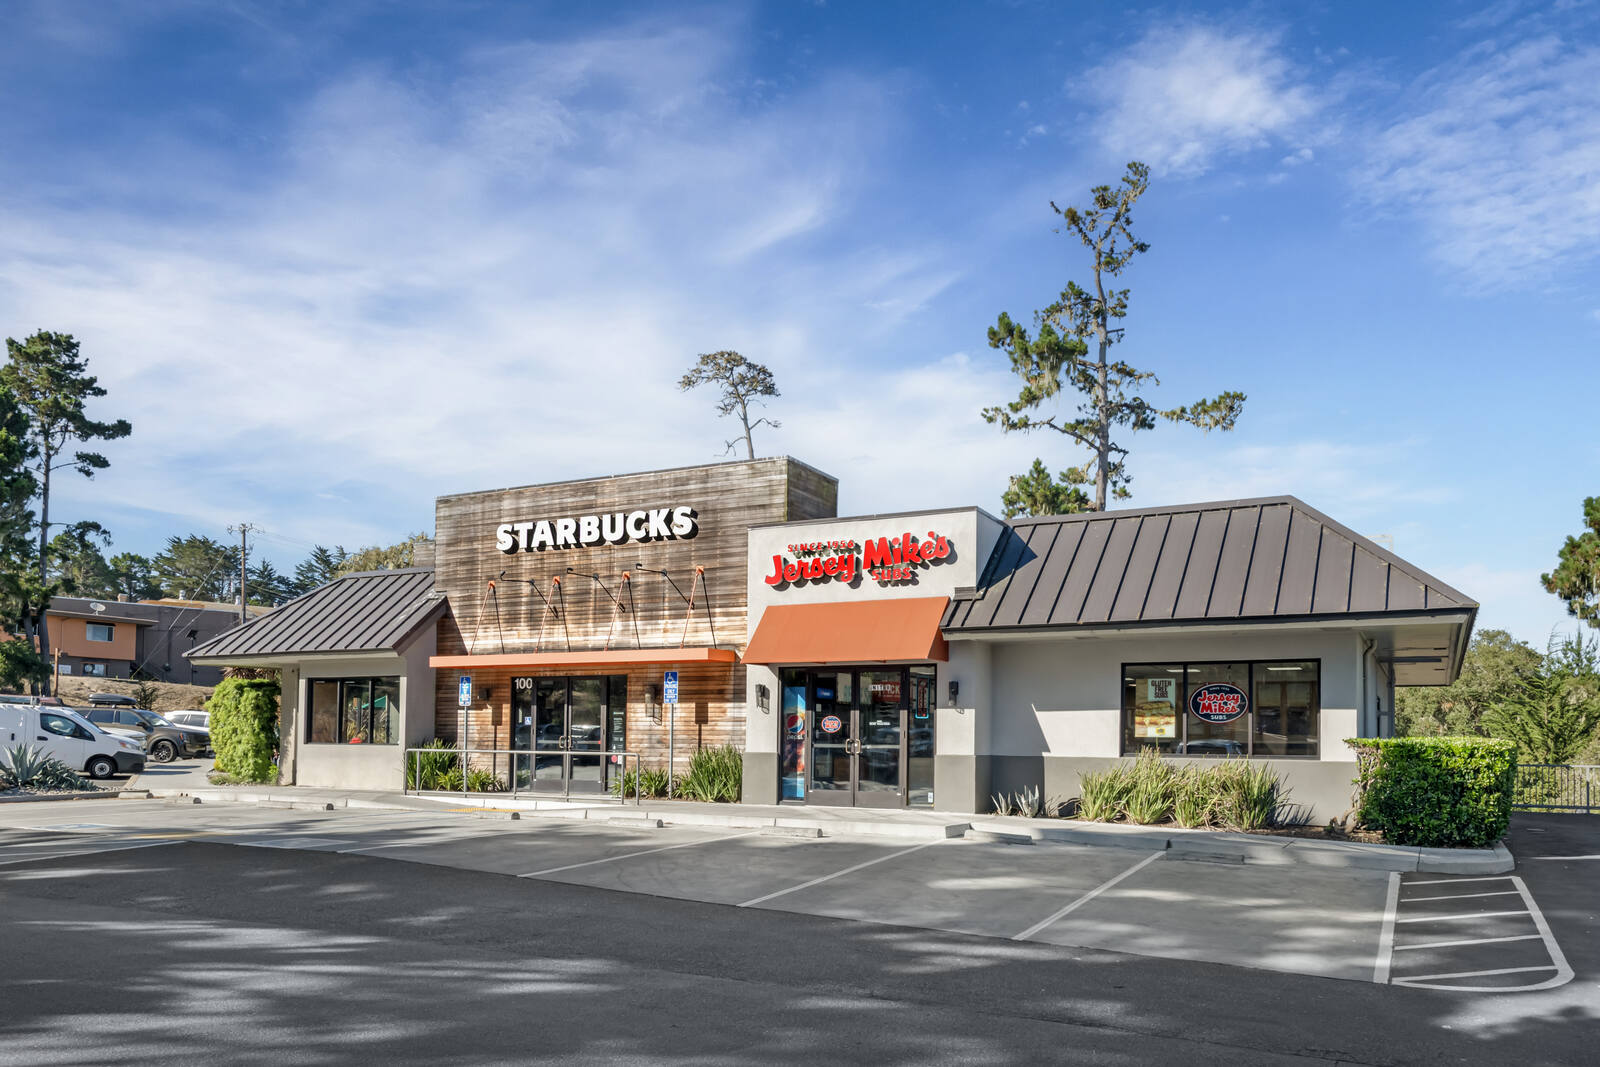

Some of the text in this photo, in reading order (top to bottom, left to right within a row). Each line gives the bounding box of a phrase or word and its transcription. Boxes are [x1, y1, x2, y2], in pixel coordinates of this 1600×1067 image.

[495, 506, 693, 551] STARBUCKS
[787, 539, 854, 552] SINCE 1956
[764, 531, 950, 585] Jersey Mike's
[871, 567, 912, 581] SUBS
[514, 677, 533, 690] 100
[1197, 690, 1240, 705] Jersey
[1199, 701, 1240, 714] Mike's
